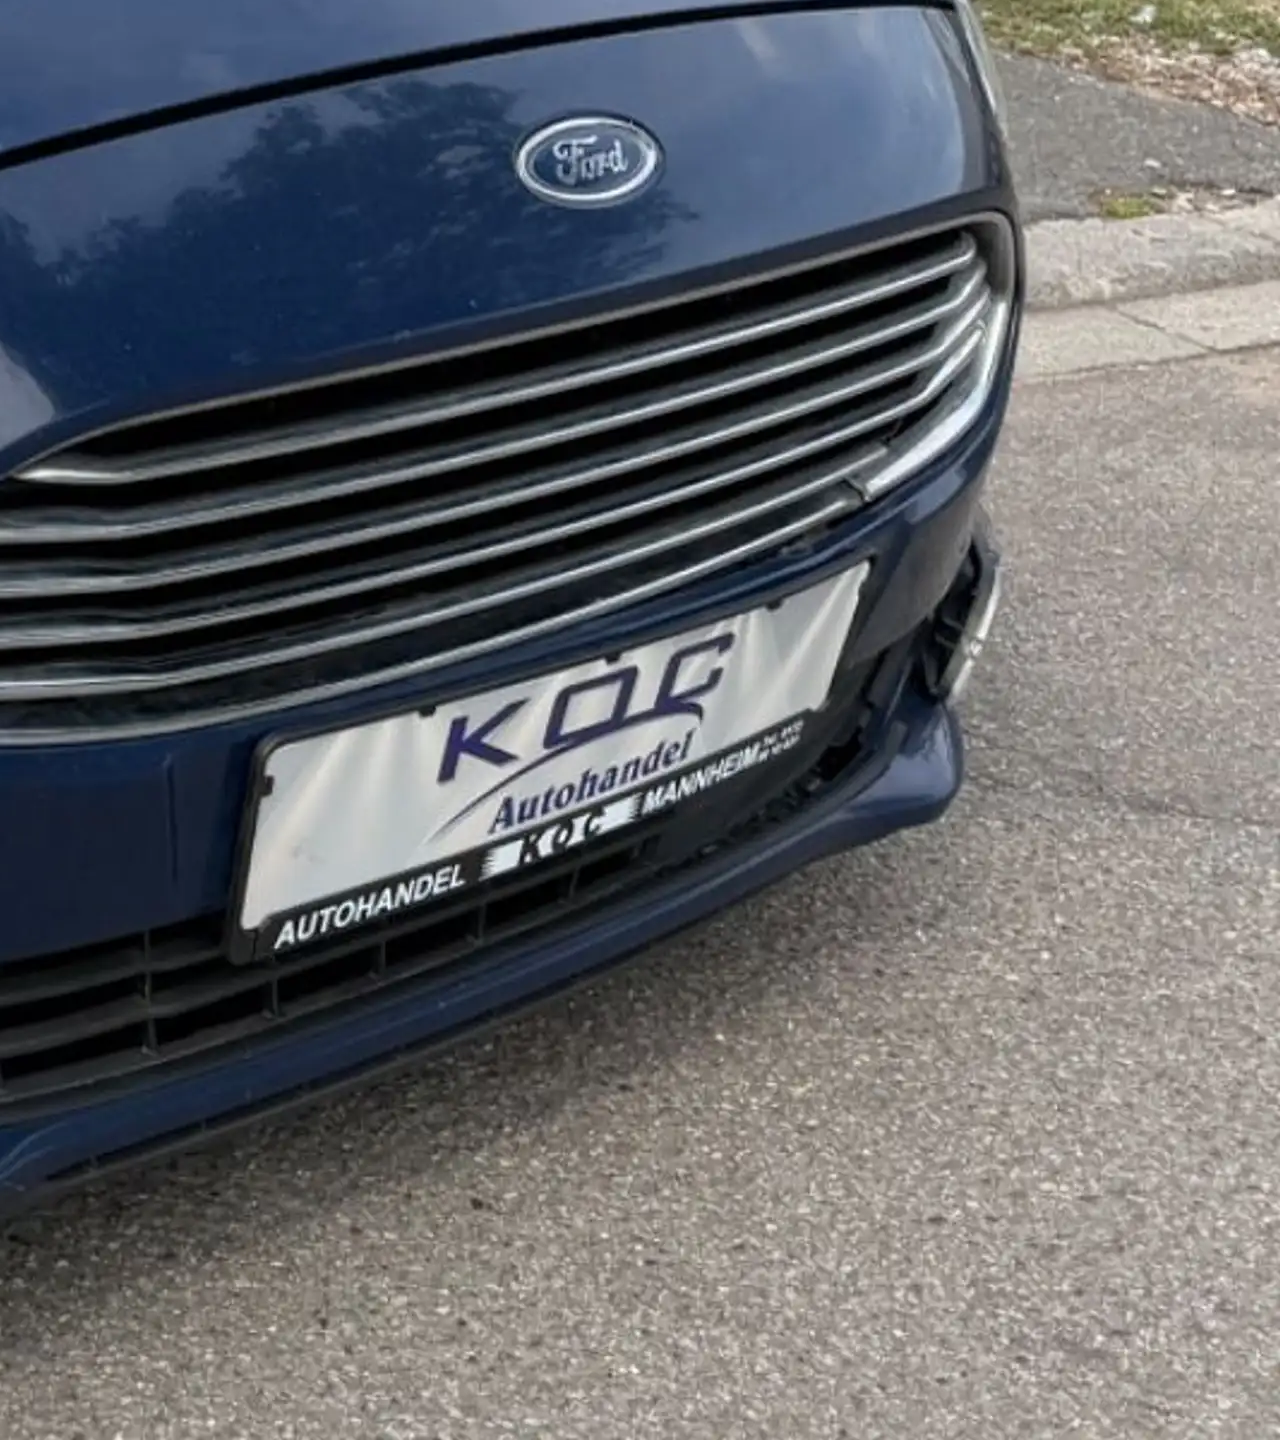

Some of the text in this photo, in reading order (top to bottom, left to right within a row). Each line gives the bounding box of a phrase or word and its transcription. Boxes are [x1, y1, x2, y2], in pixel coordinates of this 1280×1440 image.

[552, 134, 628, 186] Ford
[487, 727, 697, 835] Autohandel
[273, 863, 466, 950] AUTOHANDEL
[642, 742, 760, 816] MANNHEIM
